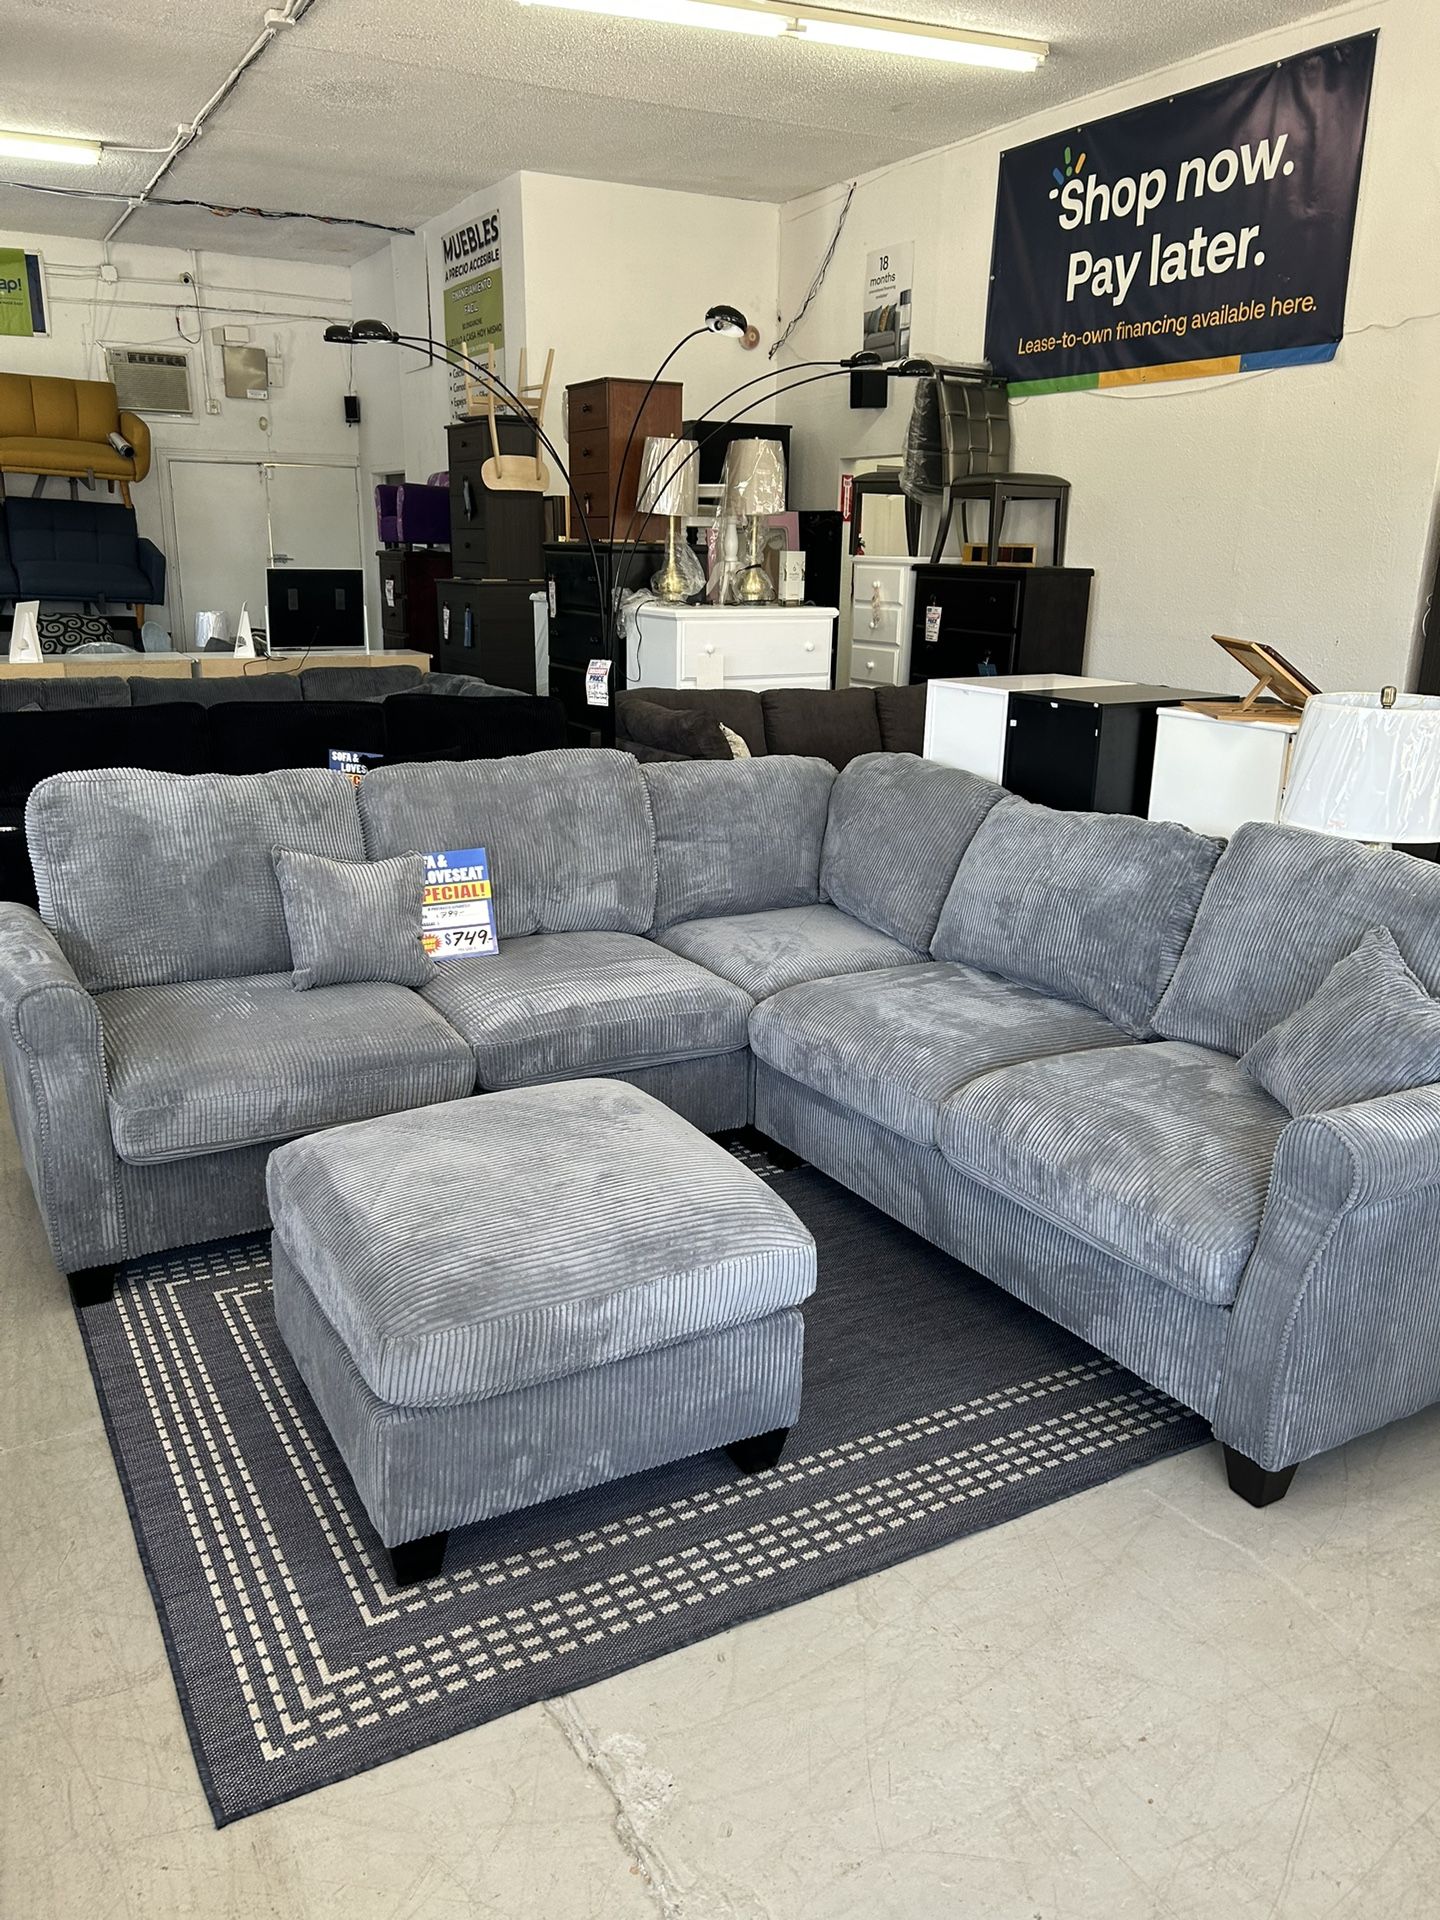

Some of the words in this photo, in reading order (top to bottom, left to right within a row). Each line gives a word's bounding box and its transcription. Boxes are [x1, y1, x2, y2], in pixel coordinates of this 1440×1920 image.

[1057, 166, 1168, 231] Shop
[1175, 133, 1295, 203] now.
[443, 215, 499, 264] MUEBLES
[469, 248, 500, 273] ACCESIBLE
[880, 255, 889, 271] 18
[1065, 250, 1142, 307] Pay
[1148, 224, 1266, 287] later.
[0, 278, 22, 293] ap!
[869, 272, 896, 287] months
[1017, 325, 1113, 356] Lease-to-own
[1115, 314, 1188, 337] financing
[1191, 299, 1266, 329] available
[1269, 295, 1318, 318] here.
[331, 751, 352, 763] SOFA
[352, 753, 360, 763] &
[437, 854, 448, 868] &
[424, 866, 484, 885] OVESEAT
[423, 883, 485, 902] PECIAL!
